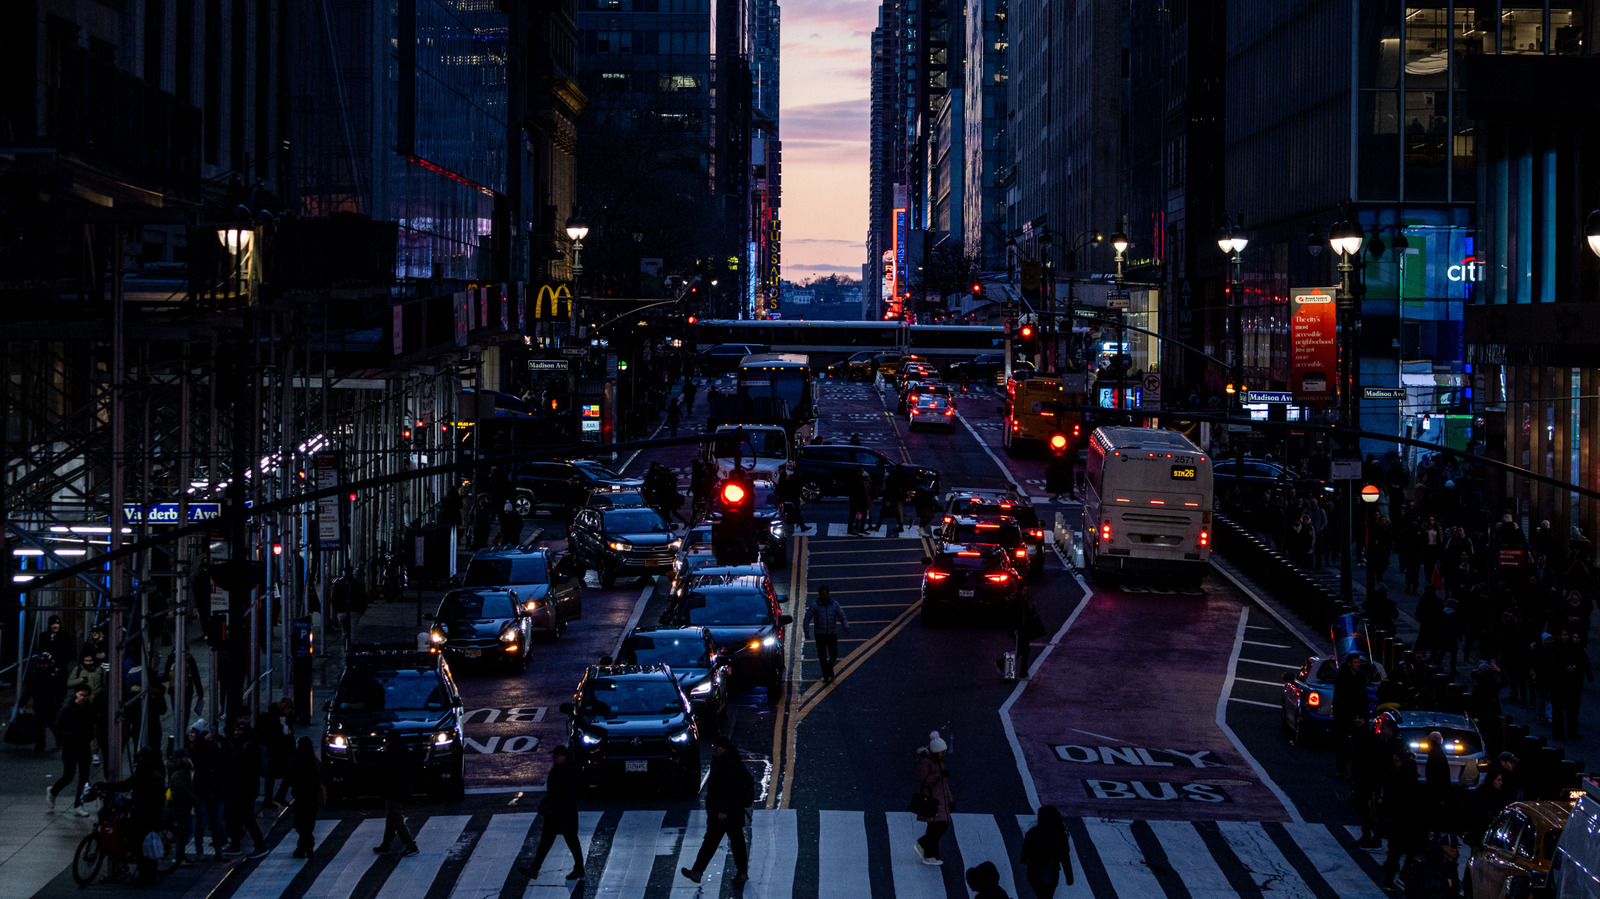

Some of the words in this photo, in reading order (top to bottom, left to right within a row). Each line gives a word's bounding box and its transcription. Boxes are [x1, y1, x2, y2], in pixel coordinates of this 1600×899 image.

[769, 219, 780, 310] TUSSAUDS
[1447, 258, 1483, 282] citi
[1295, 338, 1334, 346] neighborhood
[1249, 393, 1280, 402] Madison
[1174, 455, 1194, 464] 2571
[193, 508, 218, 520] Ave
[300, 629, 308, 640] P
[1054, 744, 1211, 768] ONLY
[1086, 779, 1225, 803] BUS
